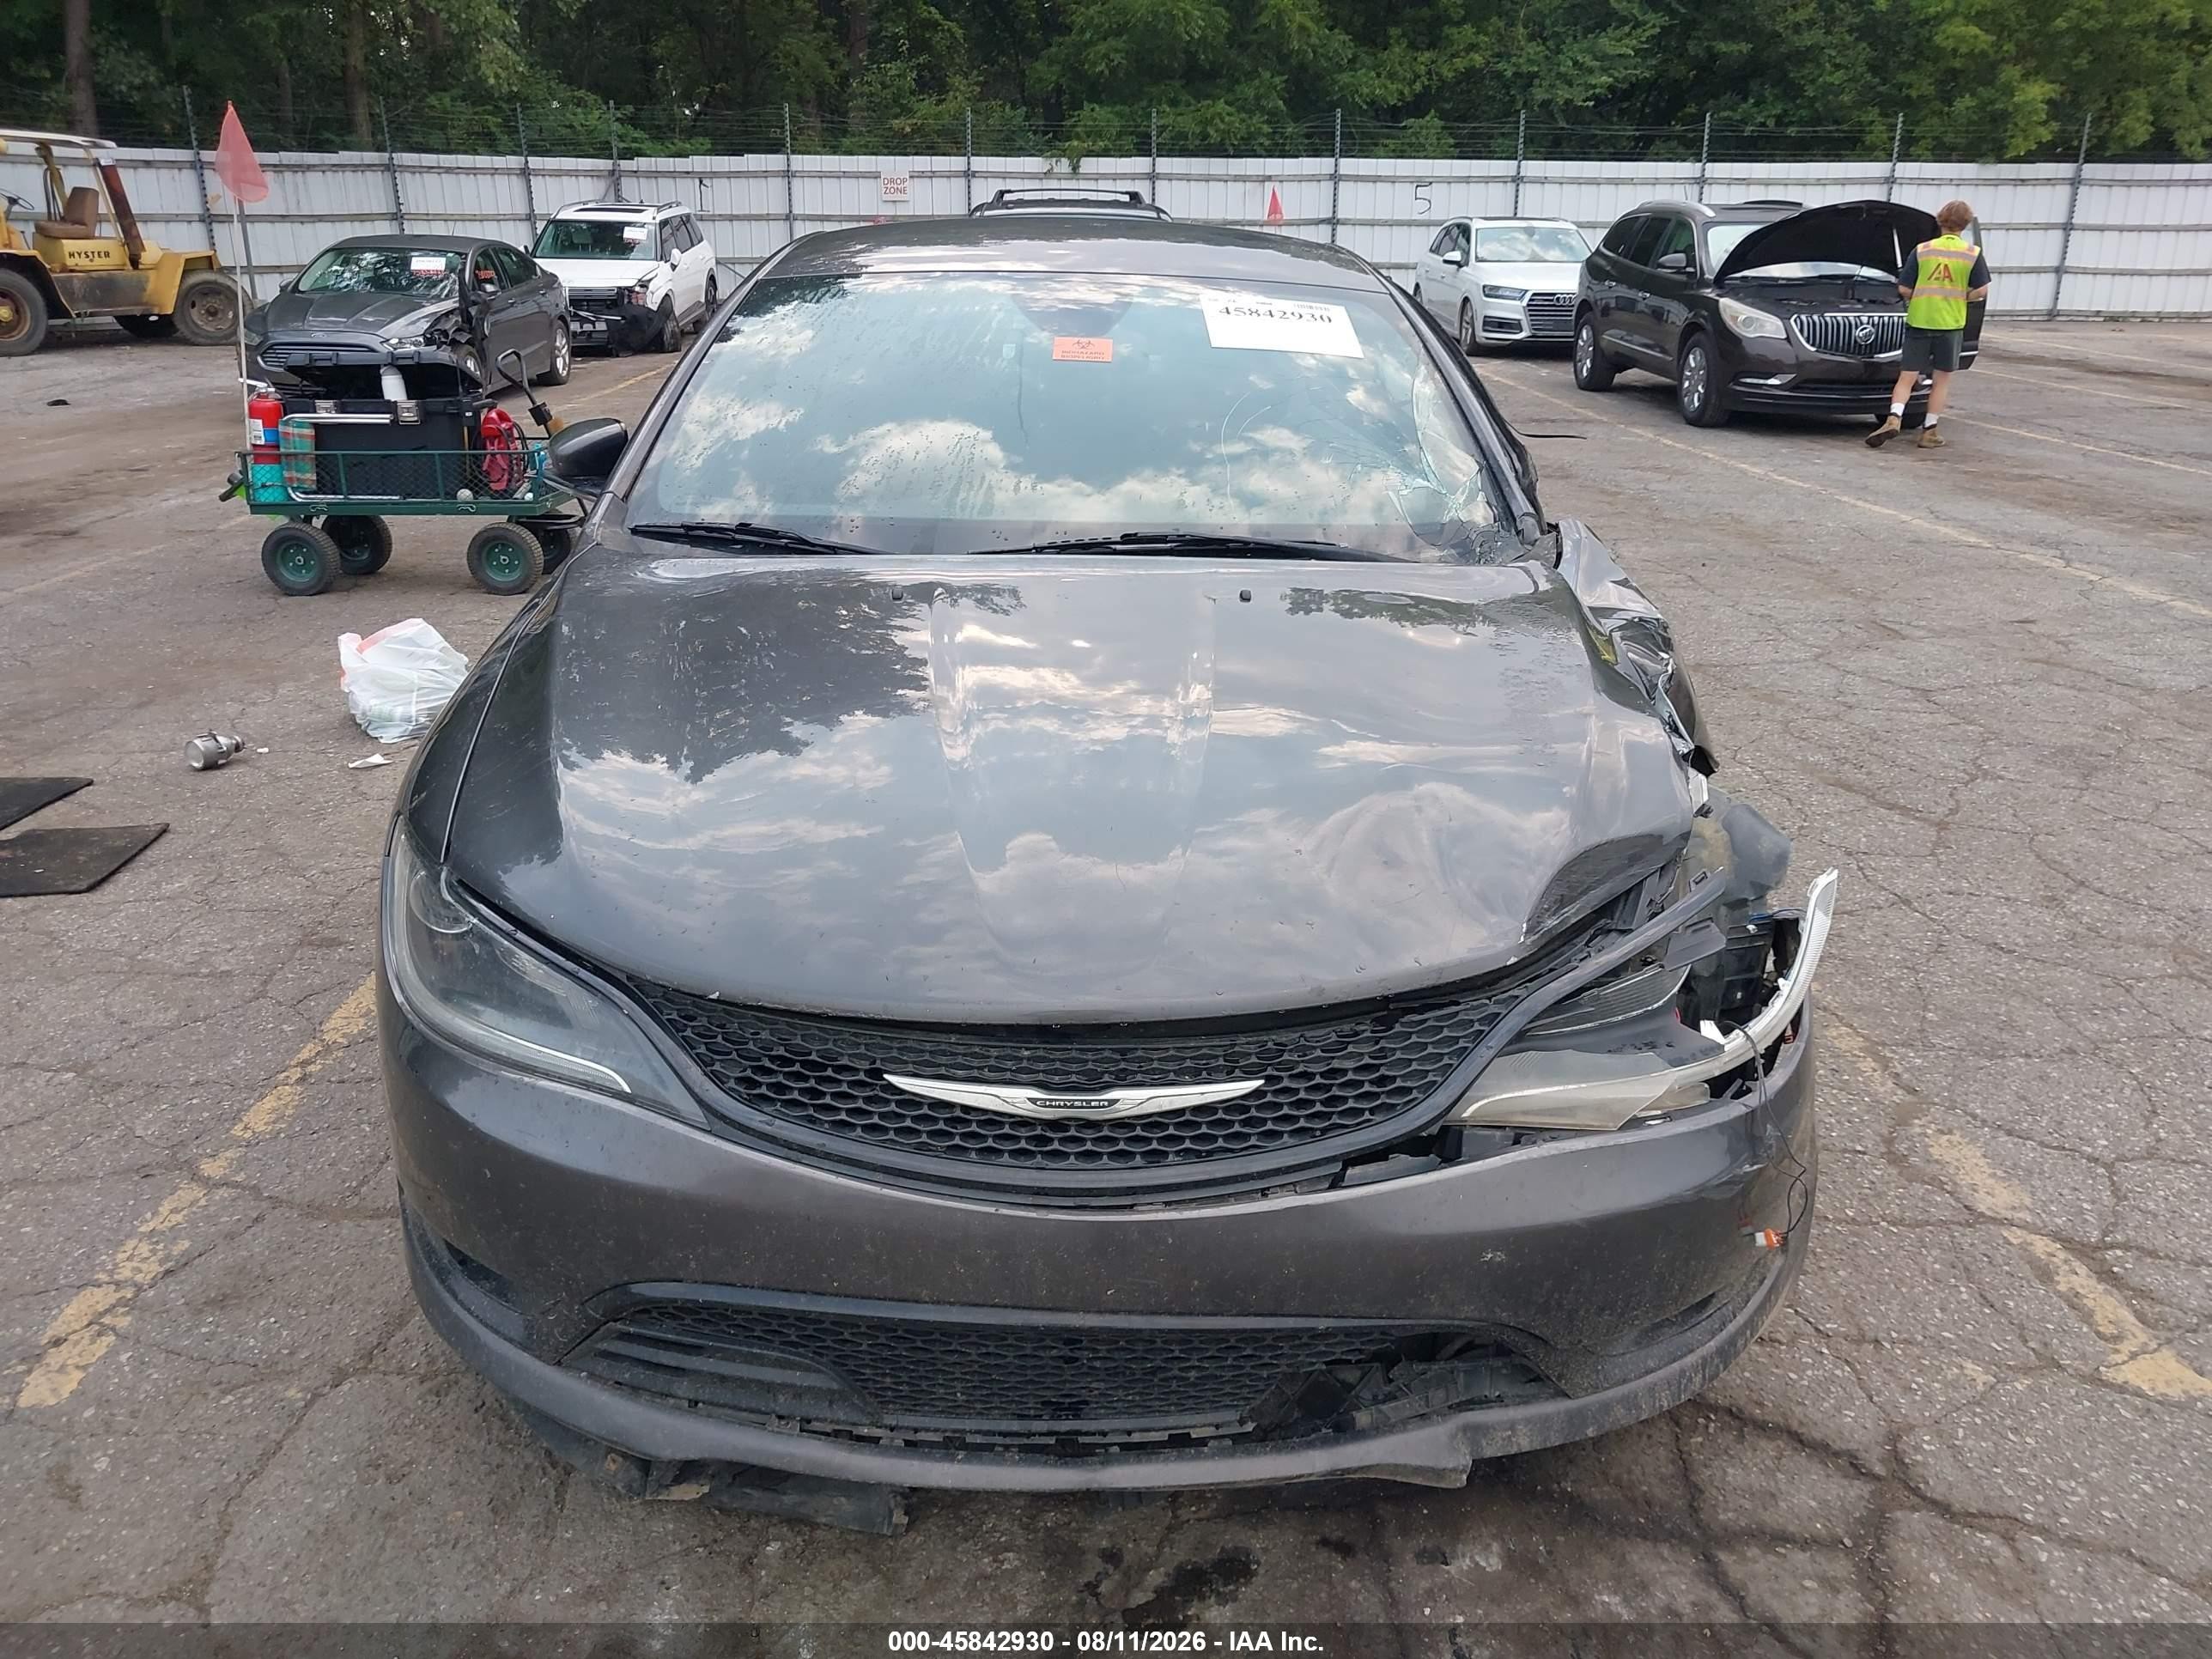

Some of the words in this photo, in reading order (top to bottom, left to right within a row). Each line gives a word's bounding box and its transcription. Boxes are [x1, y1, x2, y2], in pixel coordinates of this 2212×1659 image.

[883, 177, 908, 185] DROP
[884, 186, 908, 195] ZONE
[1414, 181, 1432, 215] 5
[1218, 306, 1332, 324] 45842930
